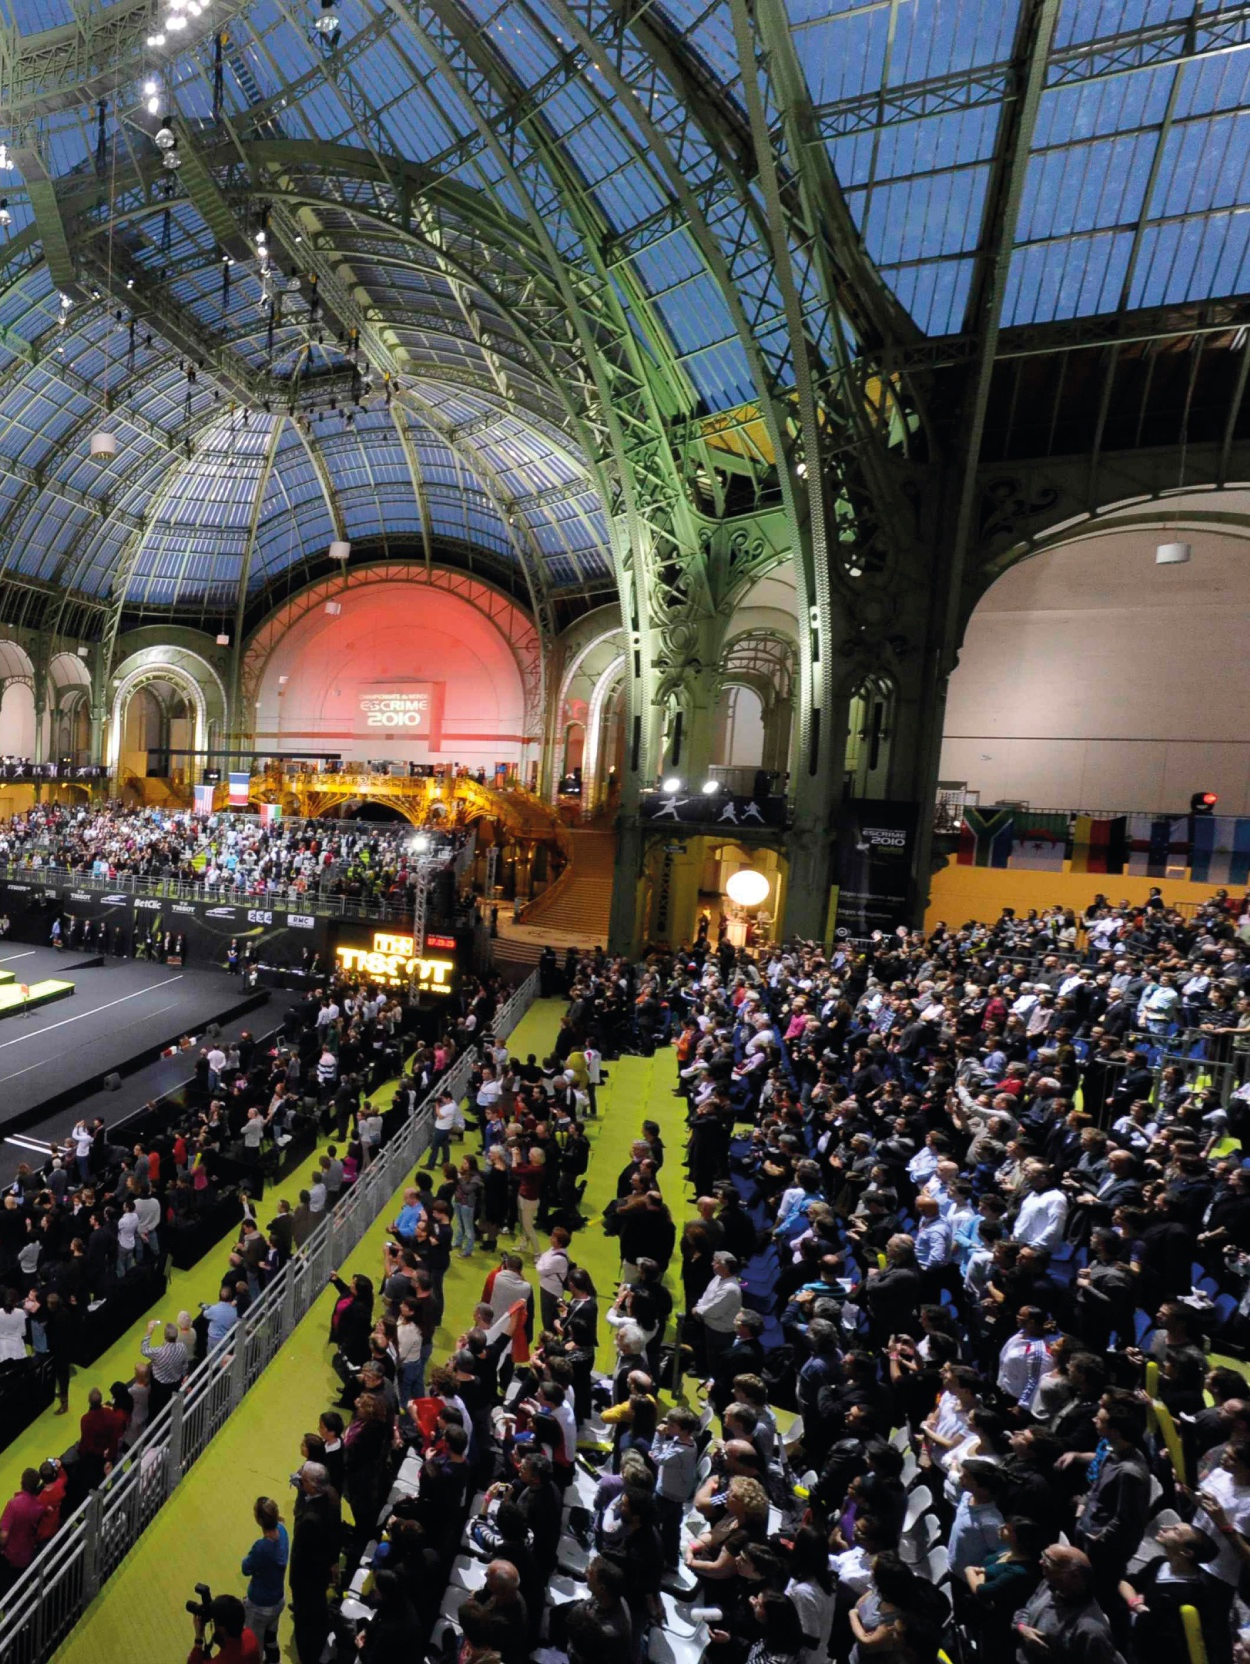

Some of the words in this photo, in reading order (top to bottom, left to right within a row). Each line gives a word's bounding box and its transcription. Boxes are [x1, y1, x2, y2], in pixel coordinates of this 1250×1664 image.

[360, 700, 428, 711] ESCRIME
[367, 711, 421, 726] 2010
[871, 836, 906, 847] 2010
[133, 899, 162, 910] BetClic
[293, 917, 310, 925] RMC
[337, 947, 453, 983] TISSOT
